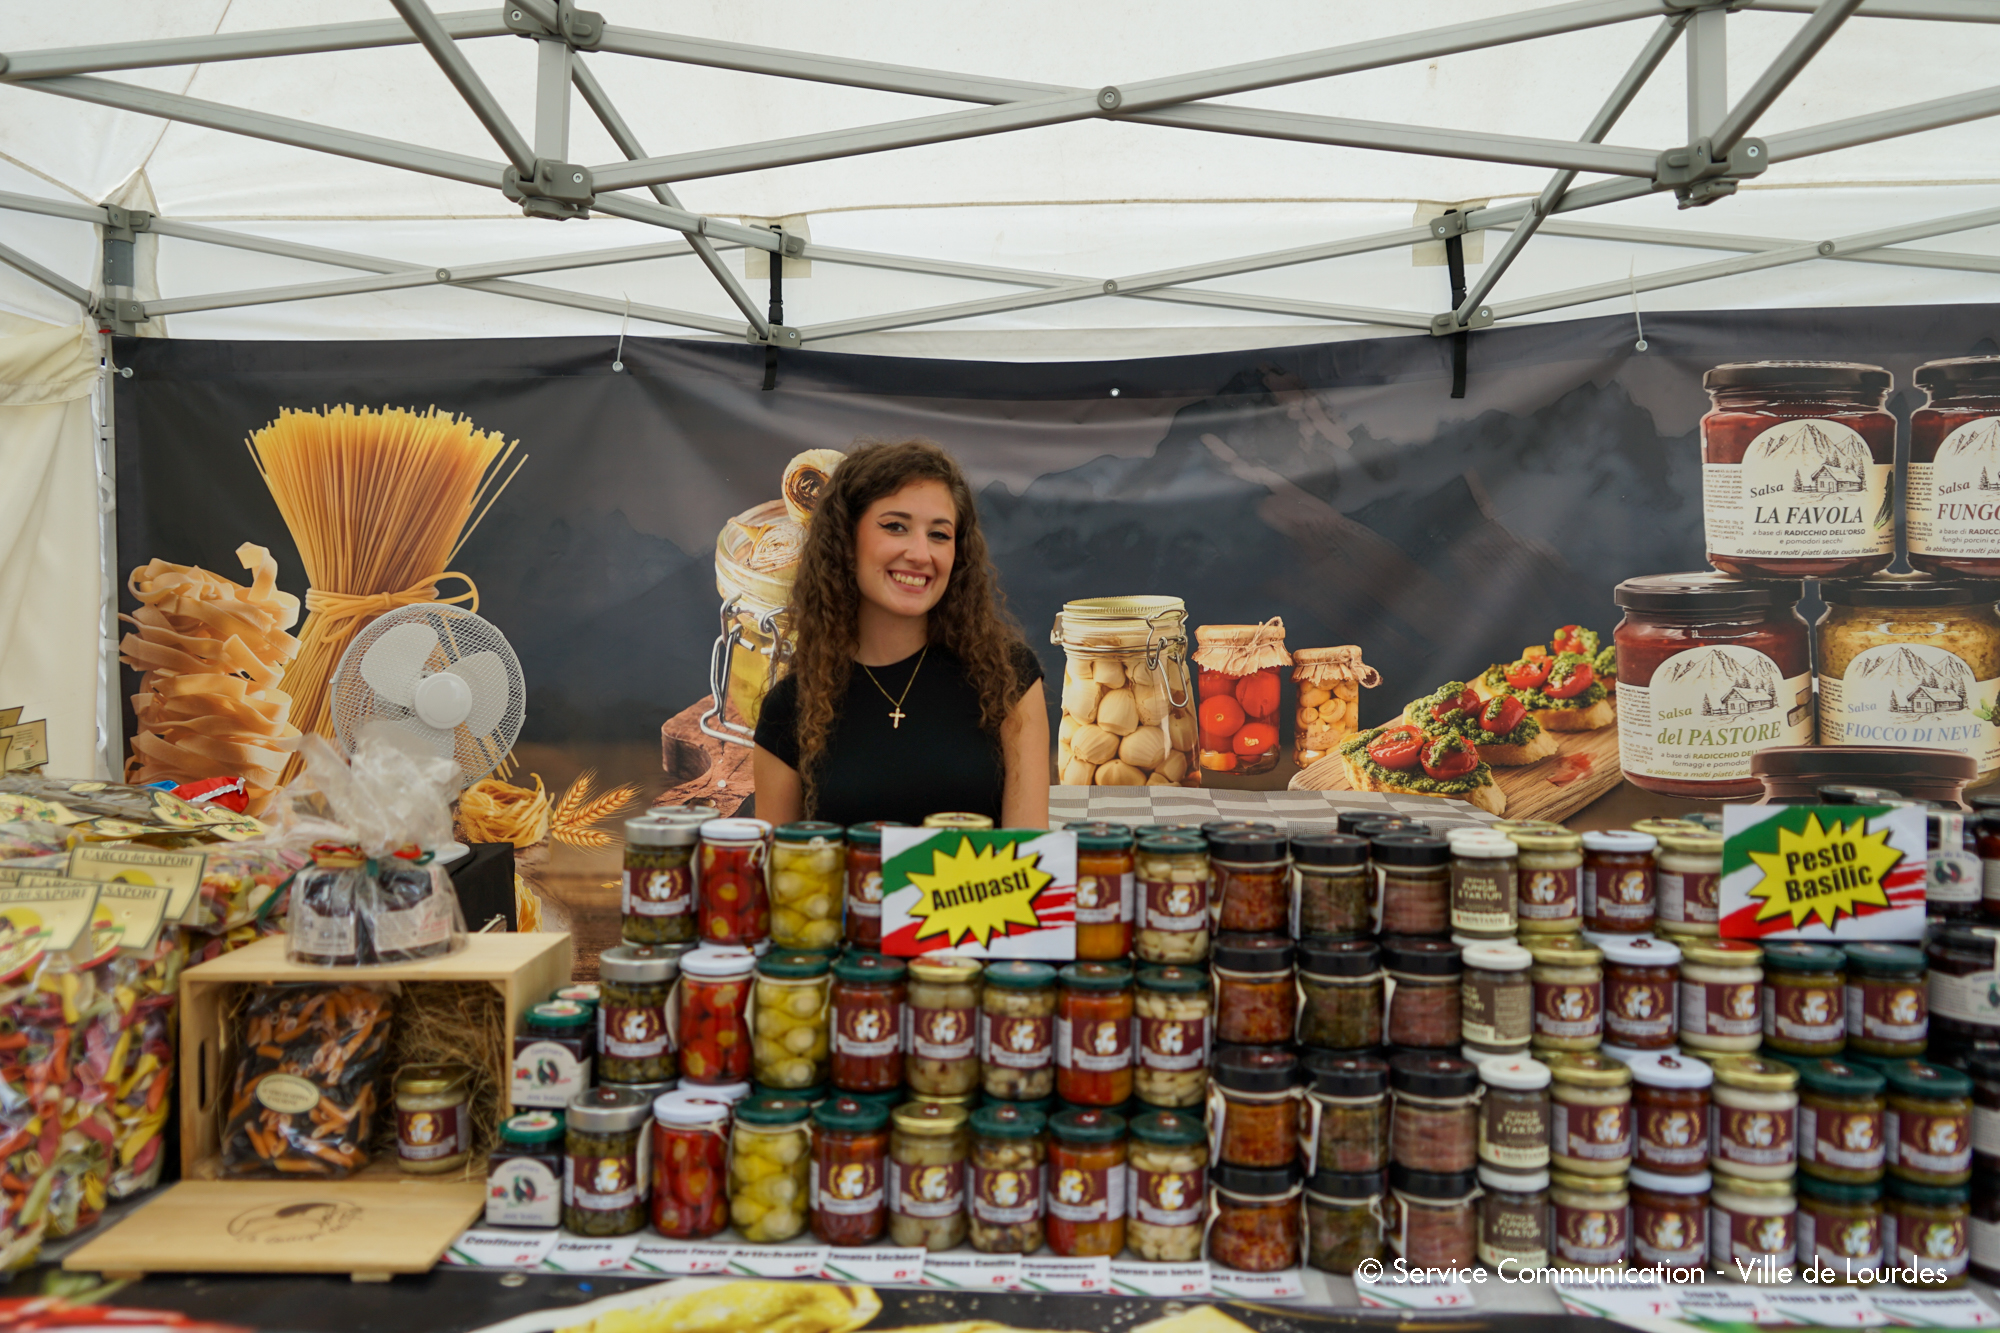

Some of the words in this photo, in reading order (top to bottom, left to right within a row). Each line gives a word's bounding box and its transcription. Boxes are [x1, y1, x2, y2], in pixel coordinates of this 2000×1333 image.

[1750, 483, 1785, 499] Salsa
[1938, 481, 1971, 497] Salsa
[1754, 506, 1781, 525] LA
[1785, 506, 1864, 525] FAVOLA
[1784, 529, 1828, 537] RADICCHIO
[1829, 528, 1866, 536] DELL'ORSO
[1785, 537, 1821, 546] pomodori
[1822, 537, 1844, 545] secchi
[1942, 536, 1963, 545] funghi
[1963, 536, 1989, 544] porcini
[1801, 548, 1822, 557] piatti
[1658, 706, 1693, 721] Salsa
[1847, 702, 1877, 714] Salsa
[1657, 727, 1683, 746] del
[1687, 720, 1782, 747] PASTORE
[1845, 722, 1908, 742] FIOCCO
[1912, 727, 1934, 743] DI
[1936, 723, 1983, 742] NEVE
[1692, 752, 1740, 760] RADICCHIO
[1672, 760, 1706, 769] formaggi
[147, 853, 194, 867] SAPORI
[1785, 841, 1858, 876] Pesto
[931, 867, 1031, 912] Antipasti
[1784, 863, 1875, 904] Basilic
[34, 885, 86, 899] SAPORI
[102, 885, 158, 900] SAPORI
